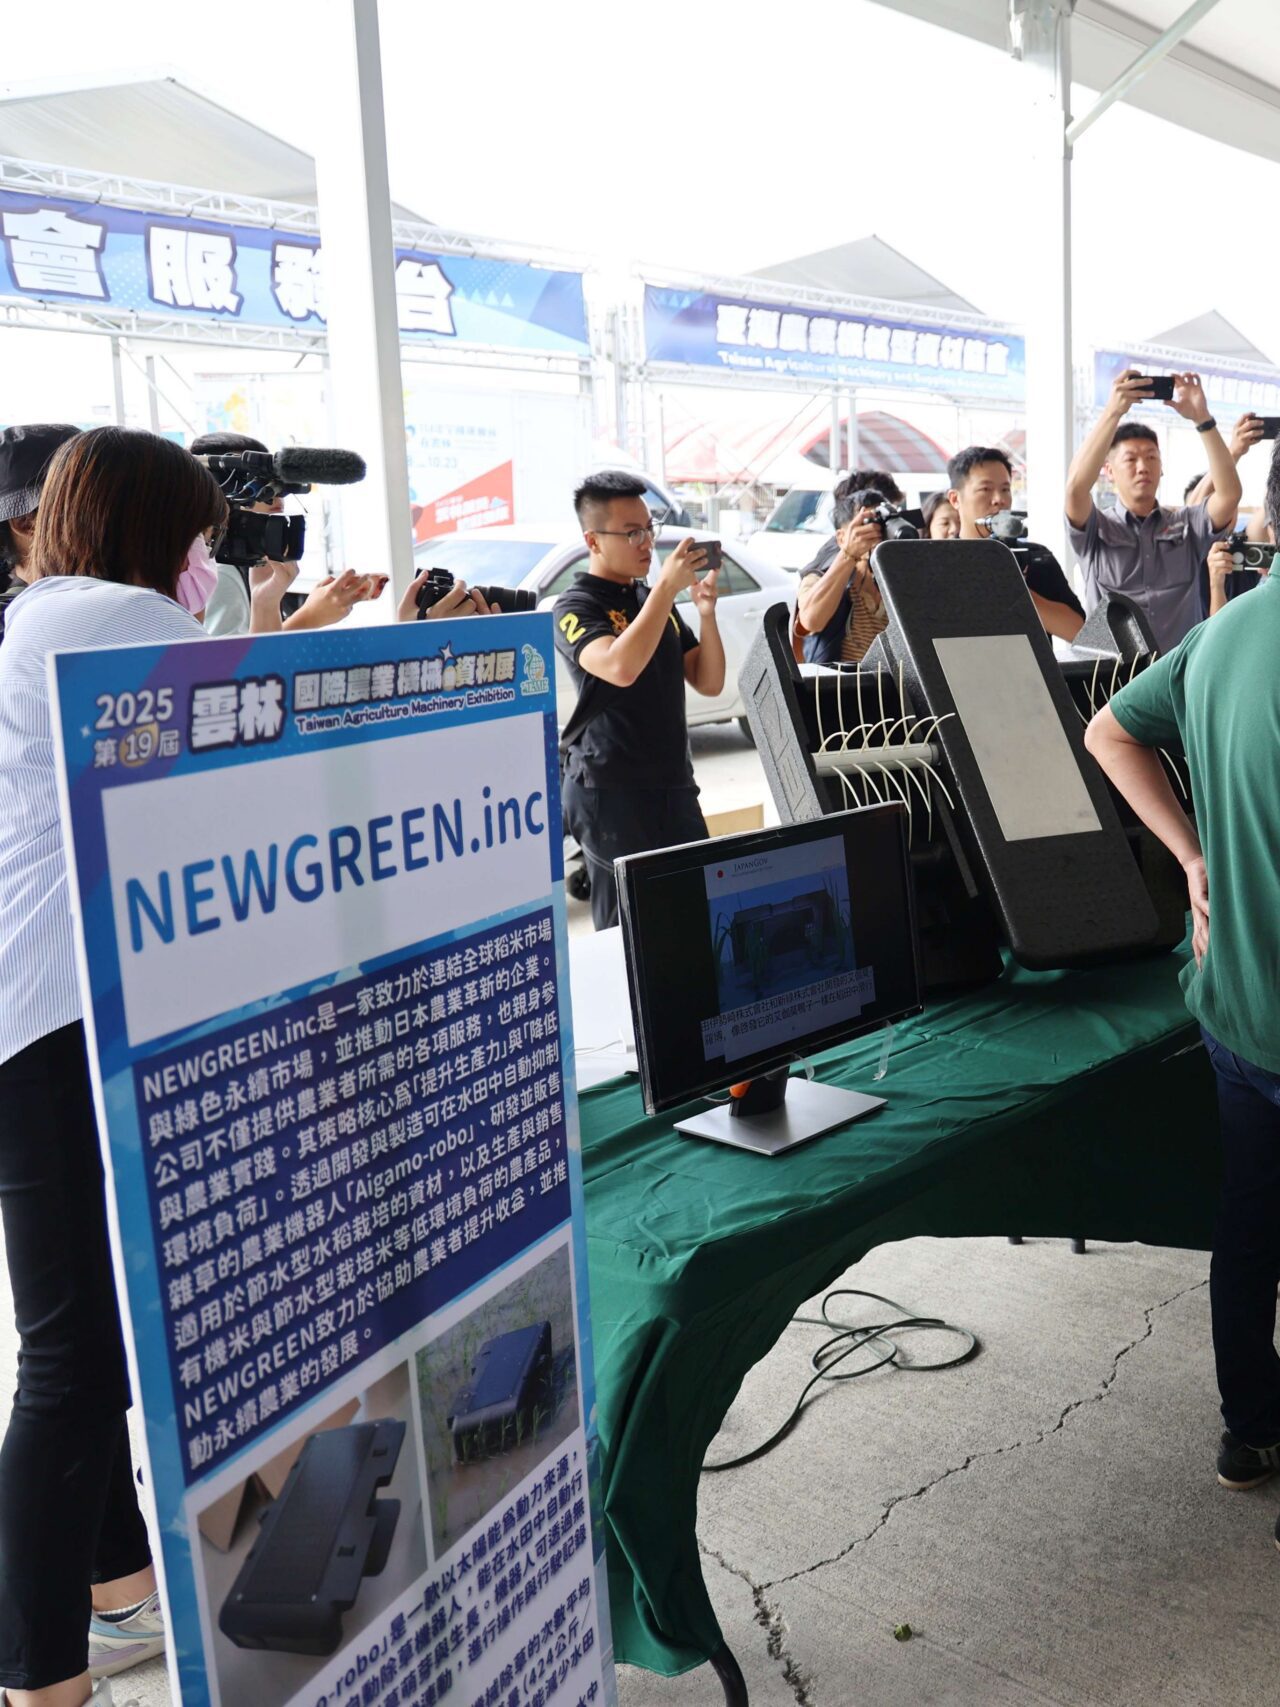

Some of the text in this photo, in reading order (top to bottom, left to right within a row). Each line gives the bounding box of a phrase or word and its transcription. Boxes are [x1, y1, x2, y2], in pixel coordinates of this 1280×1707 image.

[95, 687, 174, 730] 2025
[191, 679, 284, 749] 雲林
[297, 689, 515, 733] Taiwan Agriculture Machinery Exhibition
[94, 729, 180, 768] 第19屆
[125, 787, 545, 953] NEWGREEN.inc
[187, 1326, 372, 1471] 動永續農業的發展。
